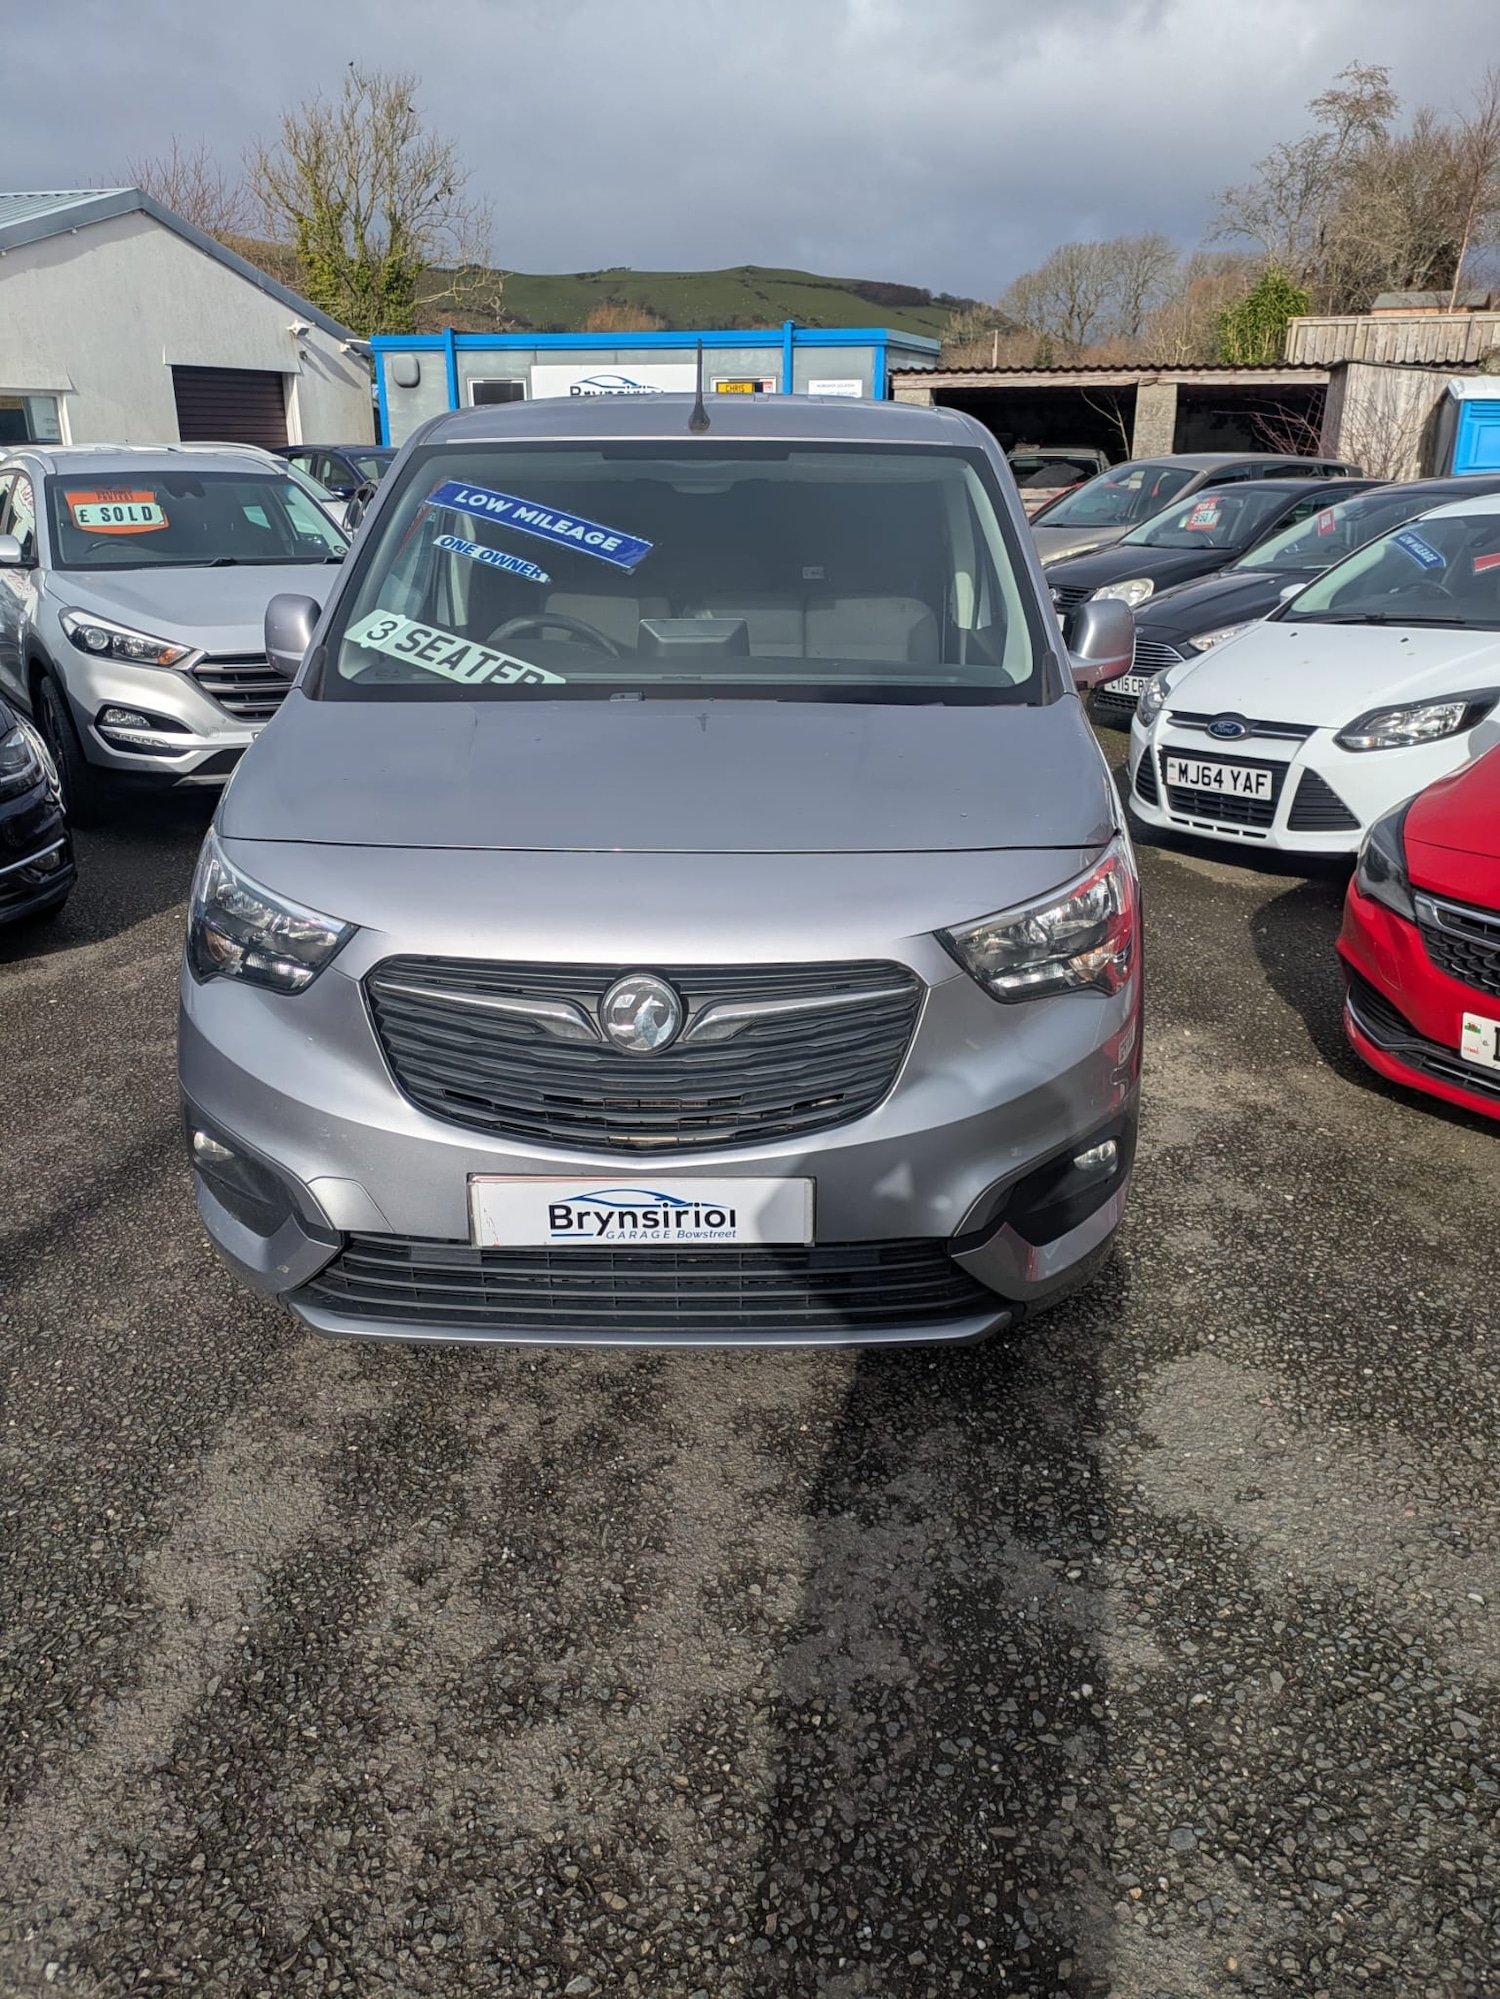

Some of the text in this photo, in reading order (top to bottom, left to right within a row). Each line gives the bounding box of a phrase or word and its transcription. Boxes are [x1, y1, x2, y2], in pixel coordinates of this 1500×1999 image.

[78, 506, 153, 523] £ SOLD
[454, 490, 623, 552] LOW MILEAGE
[439, 535, 479, 557] ONE
[367, 620, 398, 642] 3
[1178, 762, 1268, 795] MJ64 YAF
[605, 1229, 737, 1240] GARAGE Bowstreet
